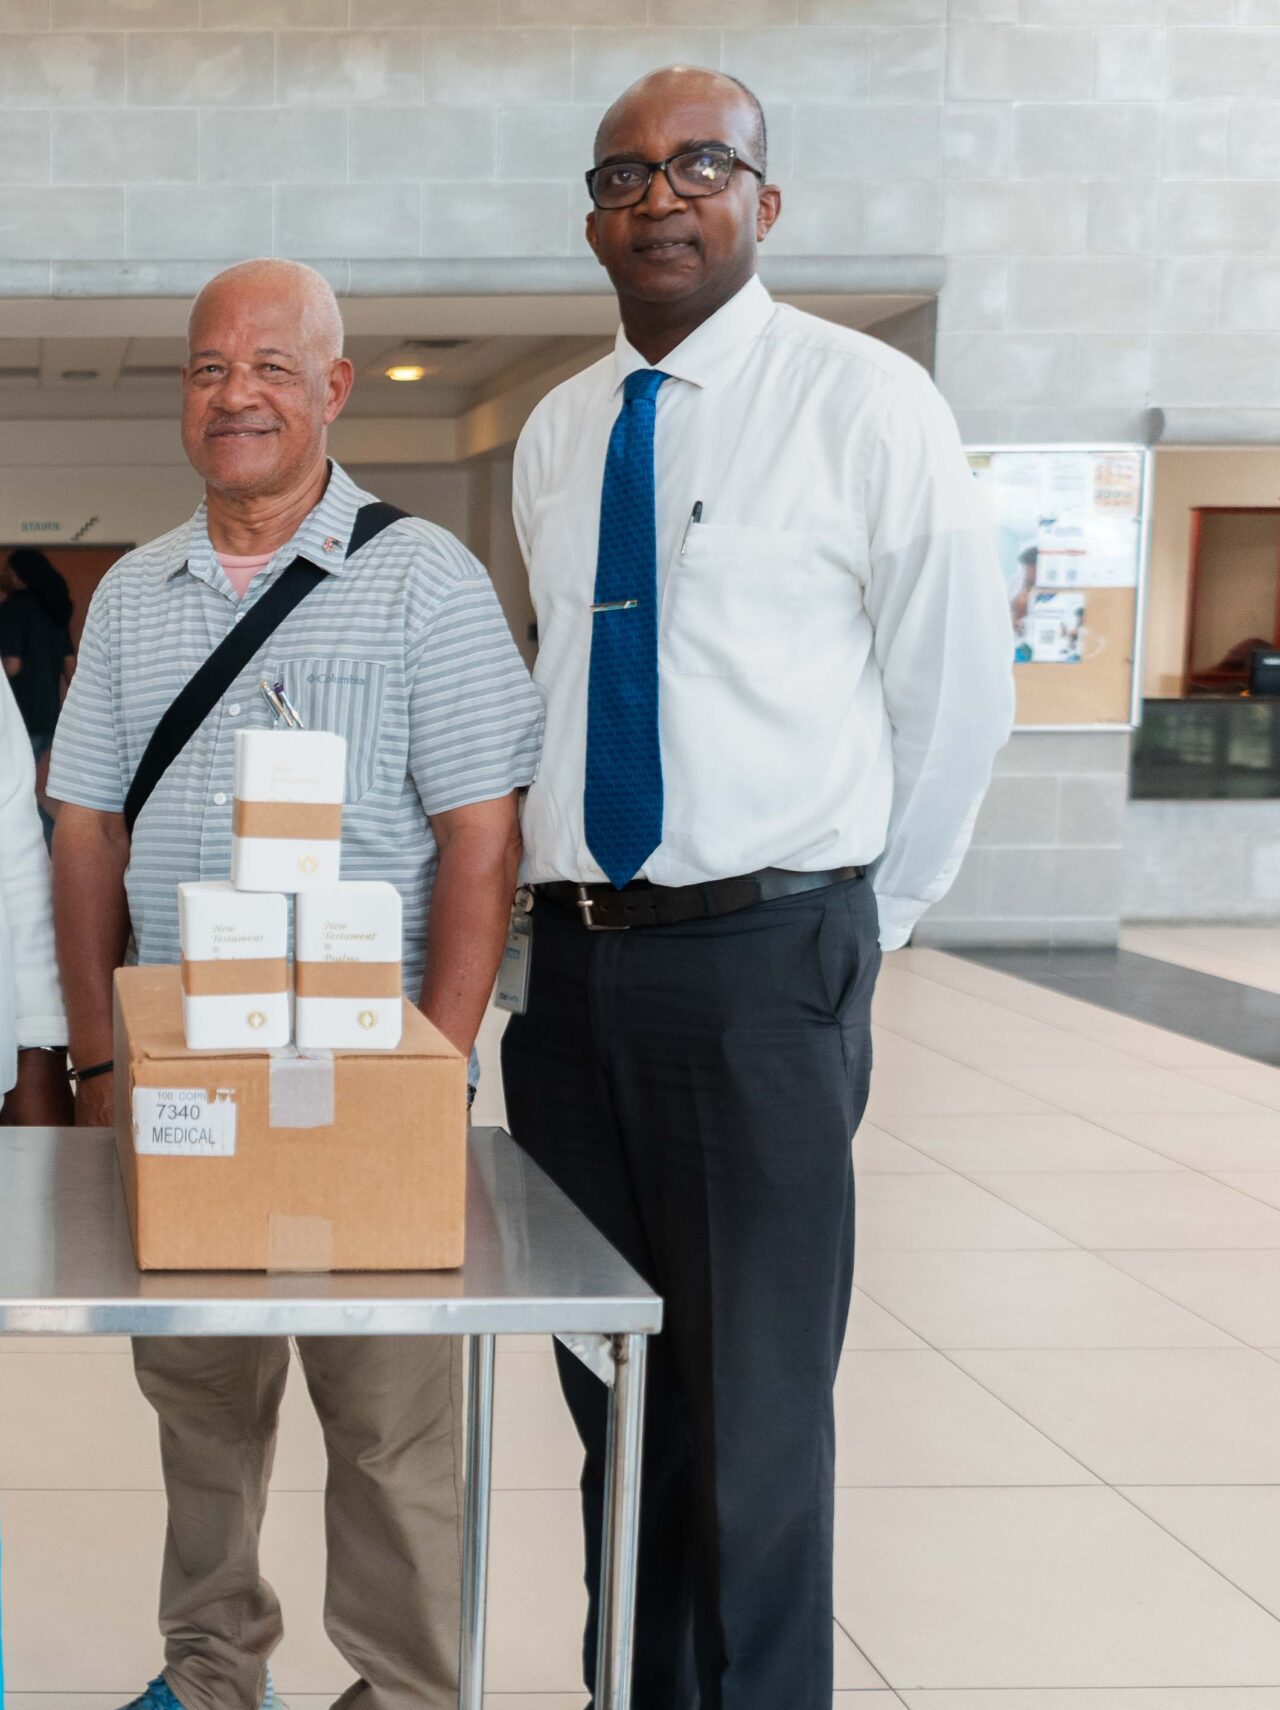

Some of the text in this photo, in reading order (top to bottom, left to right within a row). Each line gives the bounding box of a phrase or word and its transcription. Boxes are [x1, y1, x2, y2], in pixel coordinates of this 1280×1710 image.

[21, 521, 60, 532] STAIRS
[317, 673, 365, 685] Columbia
[323, 920, 348, 930] New
[210, 935, 264, 943] Testament
[322, 932, 377, 941] Testament
[157, 1091, 174, 1101] 100
[157, 1104, 200, 1120] 7340
[152, 1127, 216, 1144] MEDICAL
